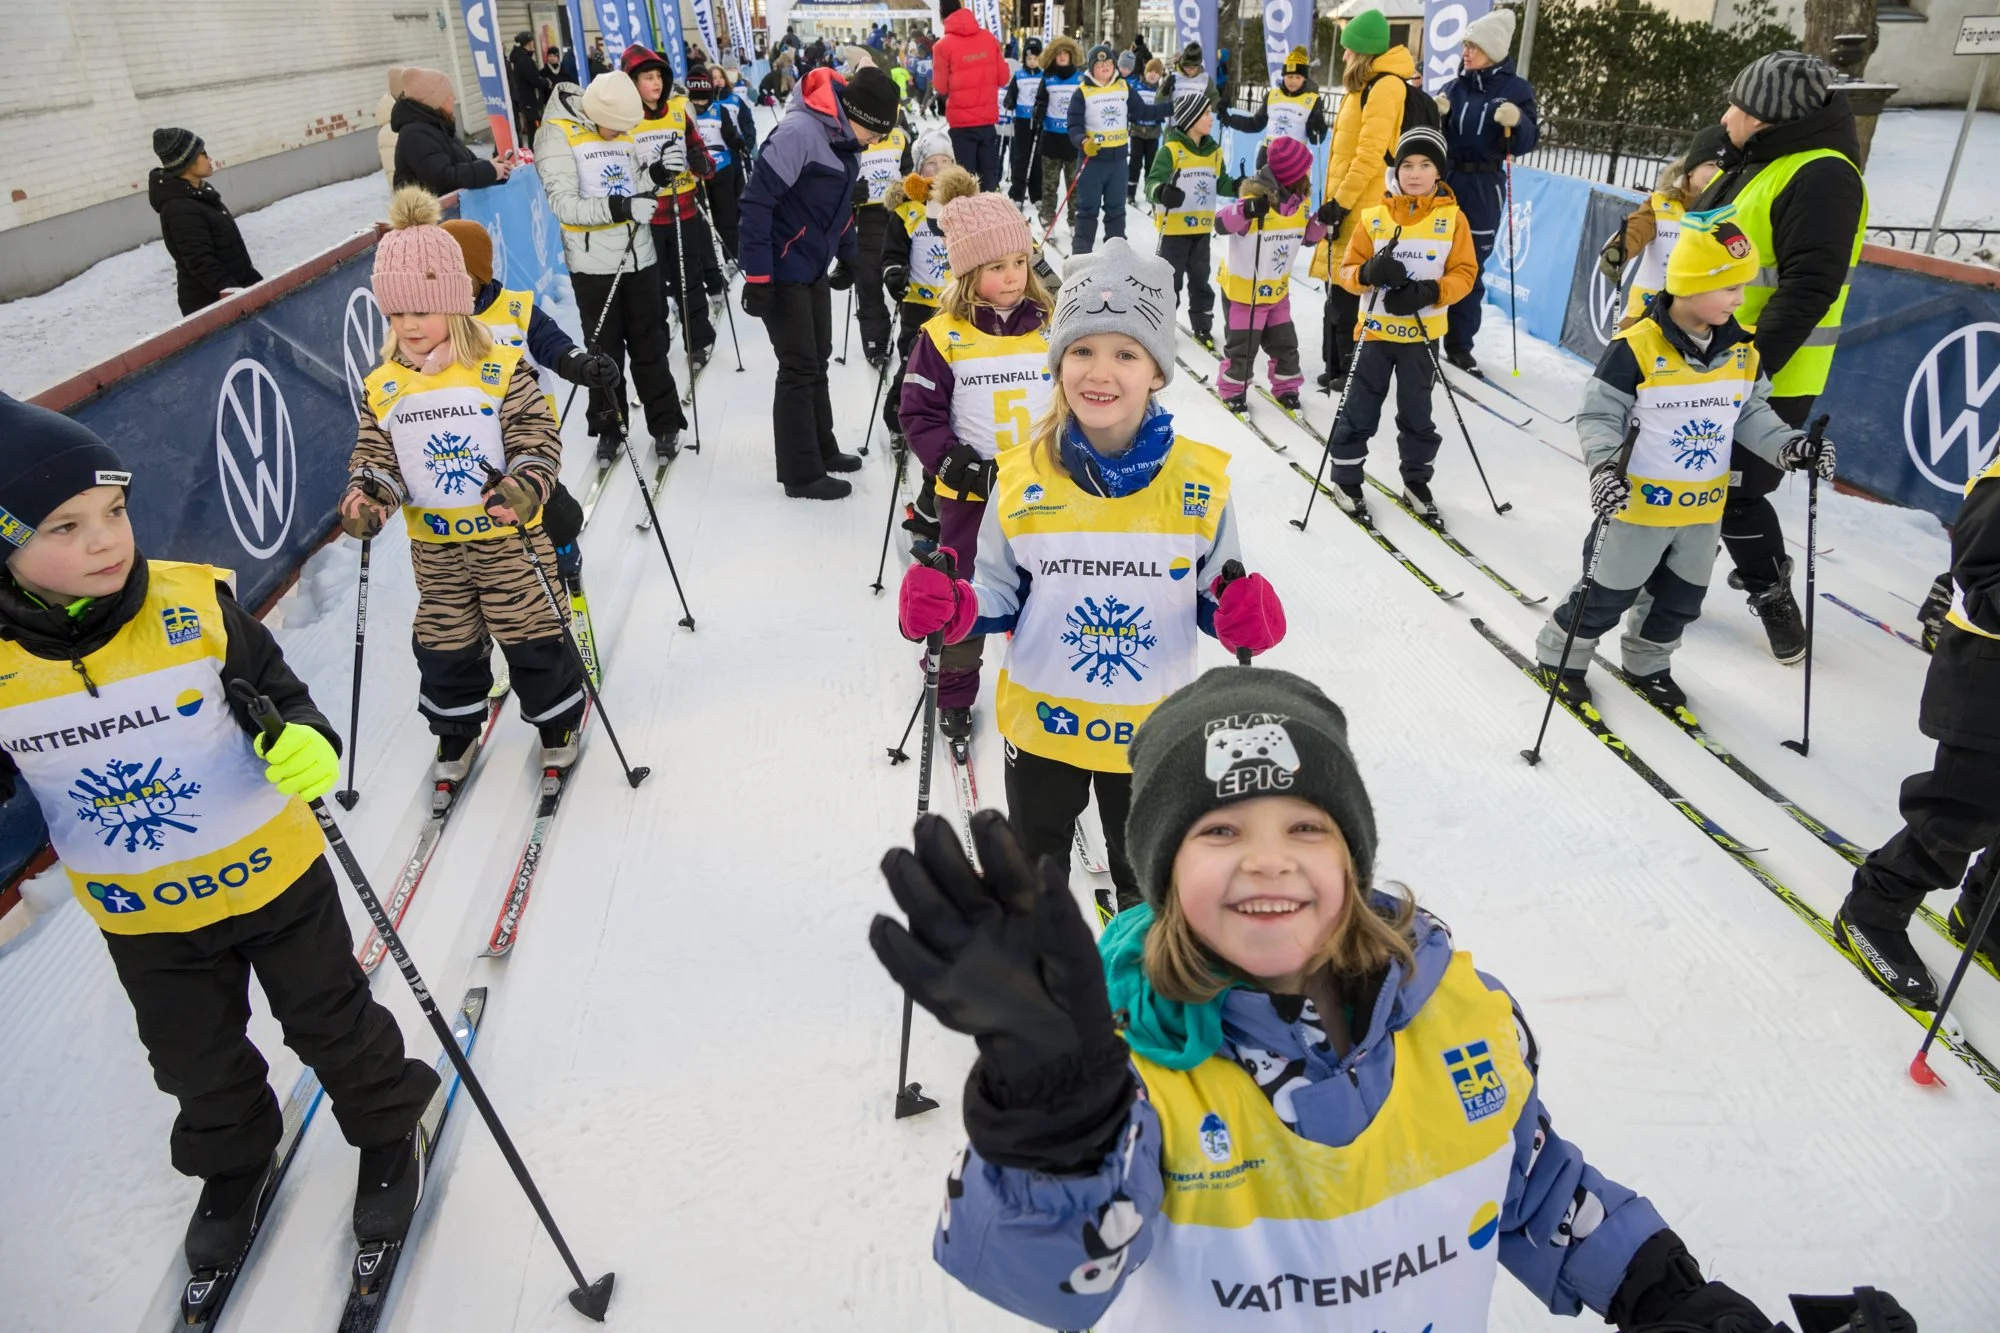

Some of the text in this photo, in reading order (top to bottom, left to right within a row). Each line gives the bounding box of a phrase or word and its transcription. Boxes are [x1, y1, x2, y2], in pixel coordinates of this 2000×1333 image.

[584, 150, 625, 160] VATTENFALL
[1391, 251, 1424, 259] ENFALL
[961, 370, 1038, 386] VATTENFALL
[1656, 397, 1730, 408] VATTENFALL
[396, 406, 477, 425] VATTENFALL
[993, 388, 1032, 452] 5
[433, 447, 471, 462] ALLA PÅ
[434, 456, 475, 475] SNÖ
[455, 515, 503, 535] OB
[1039, 558, 1162, 578] VATTENFALL
[167, 619, 199, 633] SKI
[169, 627, 200, 639] TEAM
[1082, 622, 1138, 637] ALLA PÅ
[1079, 634, 1138, 657] SNÖ
[2, 706, 170, 754] VATTENFALL
[1086, 719, 1136, 745] OB
[1205, 712, 1290, 740] PLAY
[95, 778, 167, 808] ALLA PÅ
[1216, 764, 1294, 798] EPIC
[100, 791, 177, 828] SNÖ
[153, 847, 273, 906] OBOS
[361, 857, 420, 966] MADSUS
[1847, 924, 1898, 982] FISCHER
[1458, 1069, 1501, 1099] SKI
[1463, 1086, 1506, 1111] TEAM
[1211, 1235, 1458, 1313] VATTENFALL
